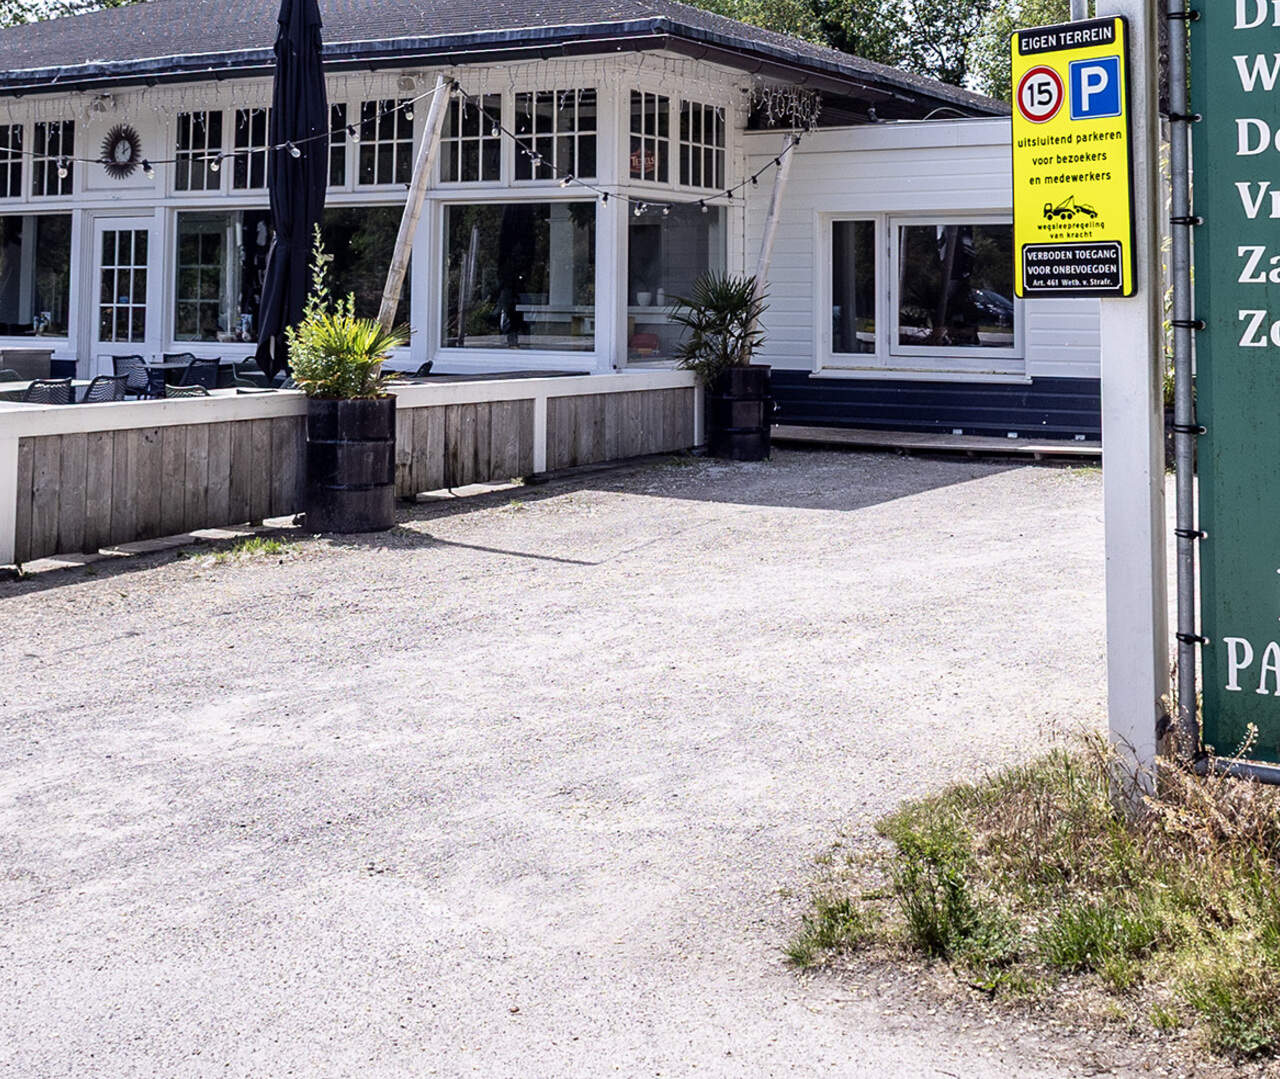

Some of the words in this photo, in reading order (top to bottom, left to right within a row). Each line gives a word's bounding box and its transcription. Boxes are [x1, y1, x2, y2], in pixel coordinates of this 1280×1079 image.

[1022, 34, 1057, 51] EIGEN
[1059, 26, 1112, 45] TERREIN
[1028, 81, 1053, 107] 15
[1081, 66, 1109, 112] P
[1017, 133, 1073, 148] uitsluitend
[1076, 131, 1122, 145] parkeren
[1032, 156, 1054, 166] voor
[1056, 152, 1108, 164] bezoekers
[1029, 176, 1042, 186] en
[1044, 171, 1112, 184] medewerkers
[1027, 251, 1073, 261] VERBODEN
[1074, 249, 1117, 259] TOEGANG
[1027, 265, 1051, 275] VOOR
[1052, 264, 1117, 274] ONBEVOEGDEN
[1032, 278, 1046, 286] Art.
[1047, 278, 1059, 286] 461
